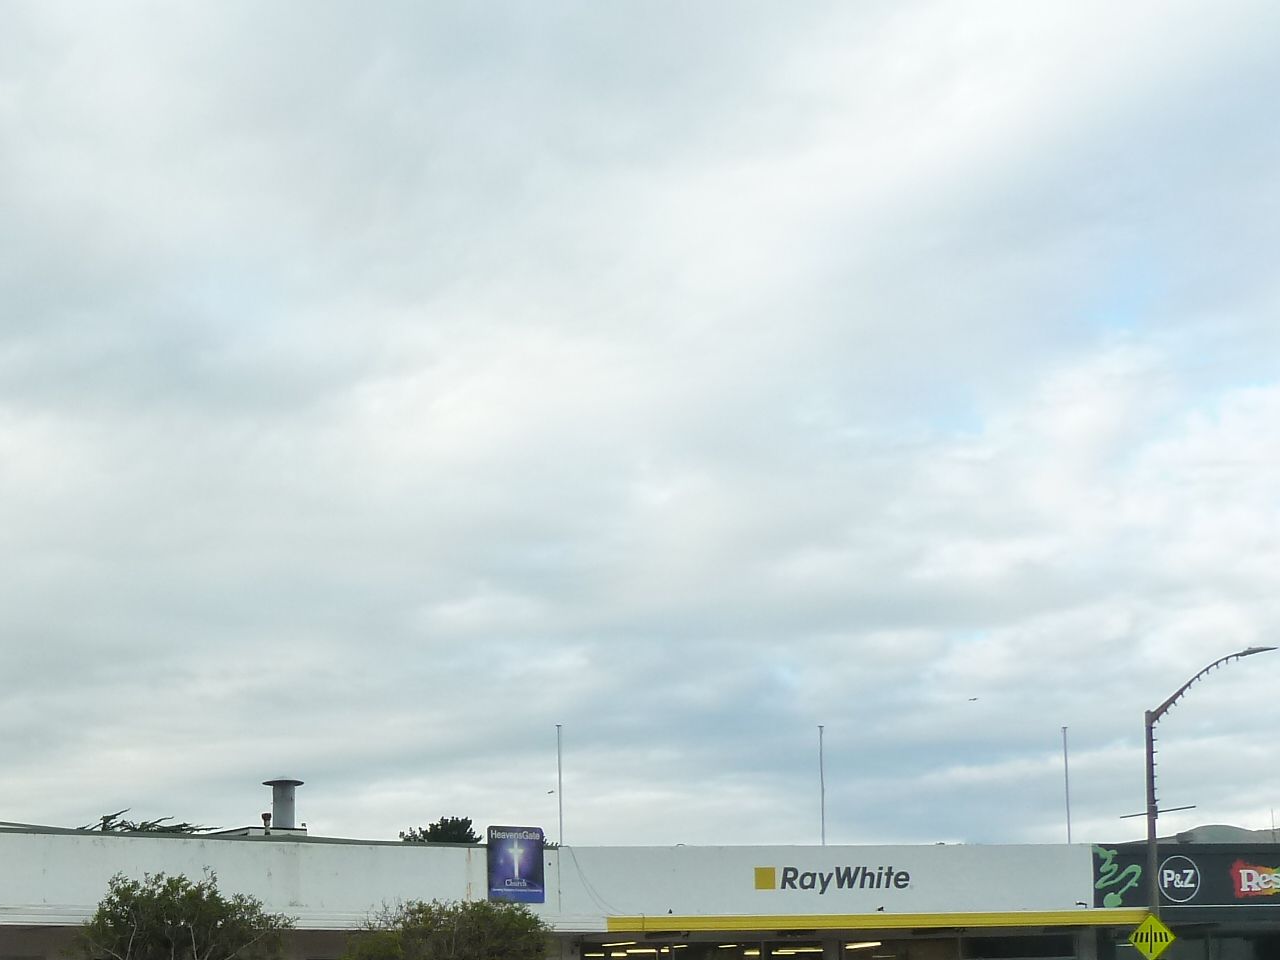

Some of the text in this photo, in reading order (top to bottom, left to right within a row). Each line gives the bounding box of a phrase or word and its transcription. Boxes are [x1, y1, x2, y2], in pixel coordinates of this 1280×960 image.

[490, 830, 540, 840] HeavensGate
[505, 879, 527, 887] Church
[1163, 869, 1195, 888] P&Z
